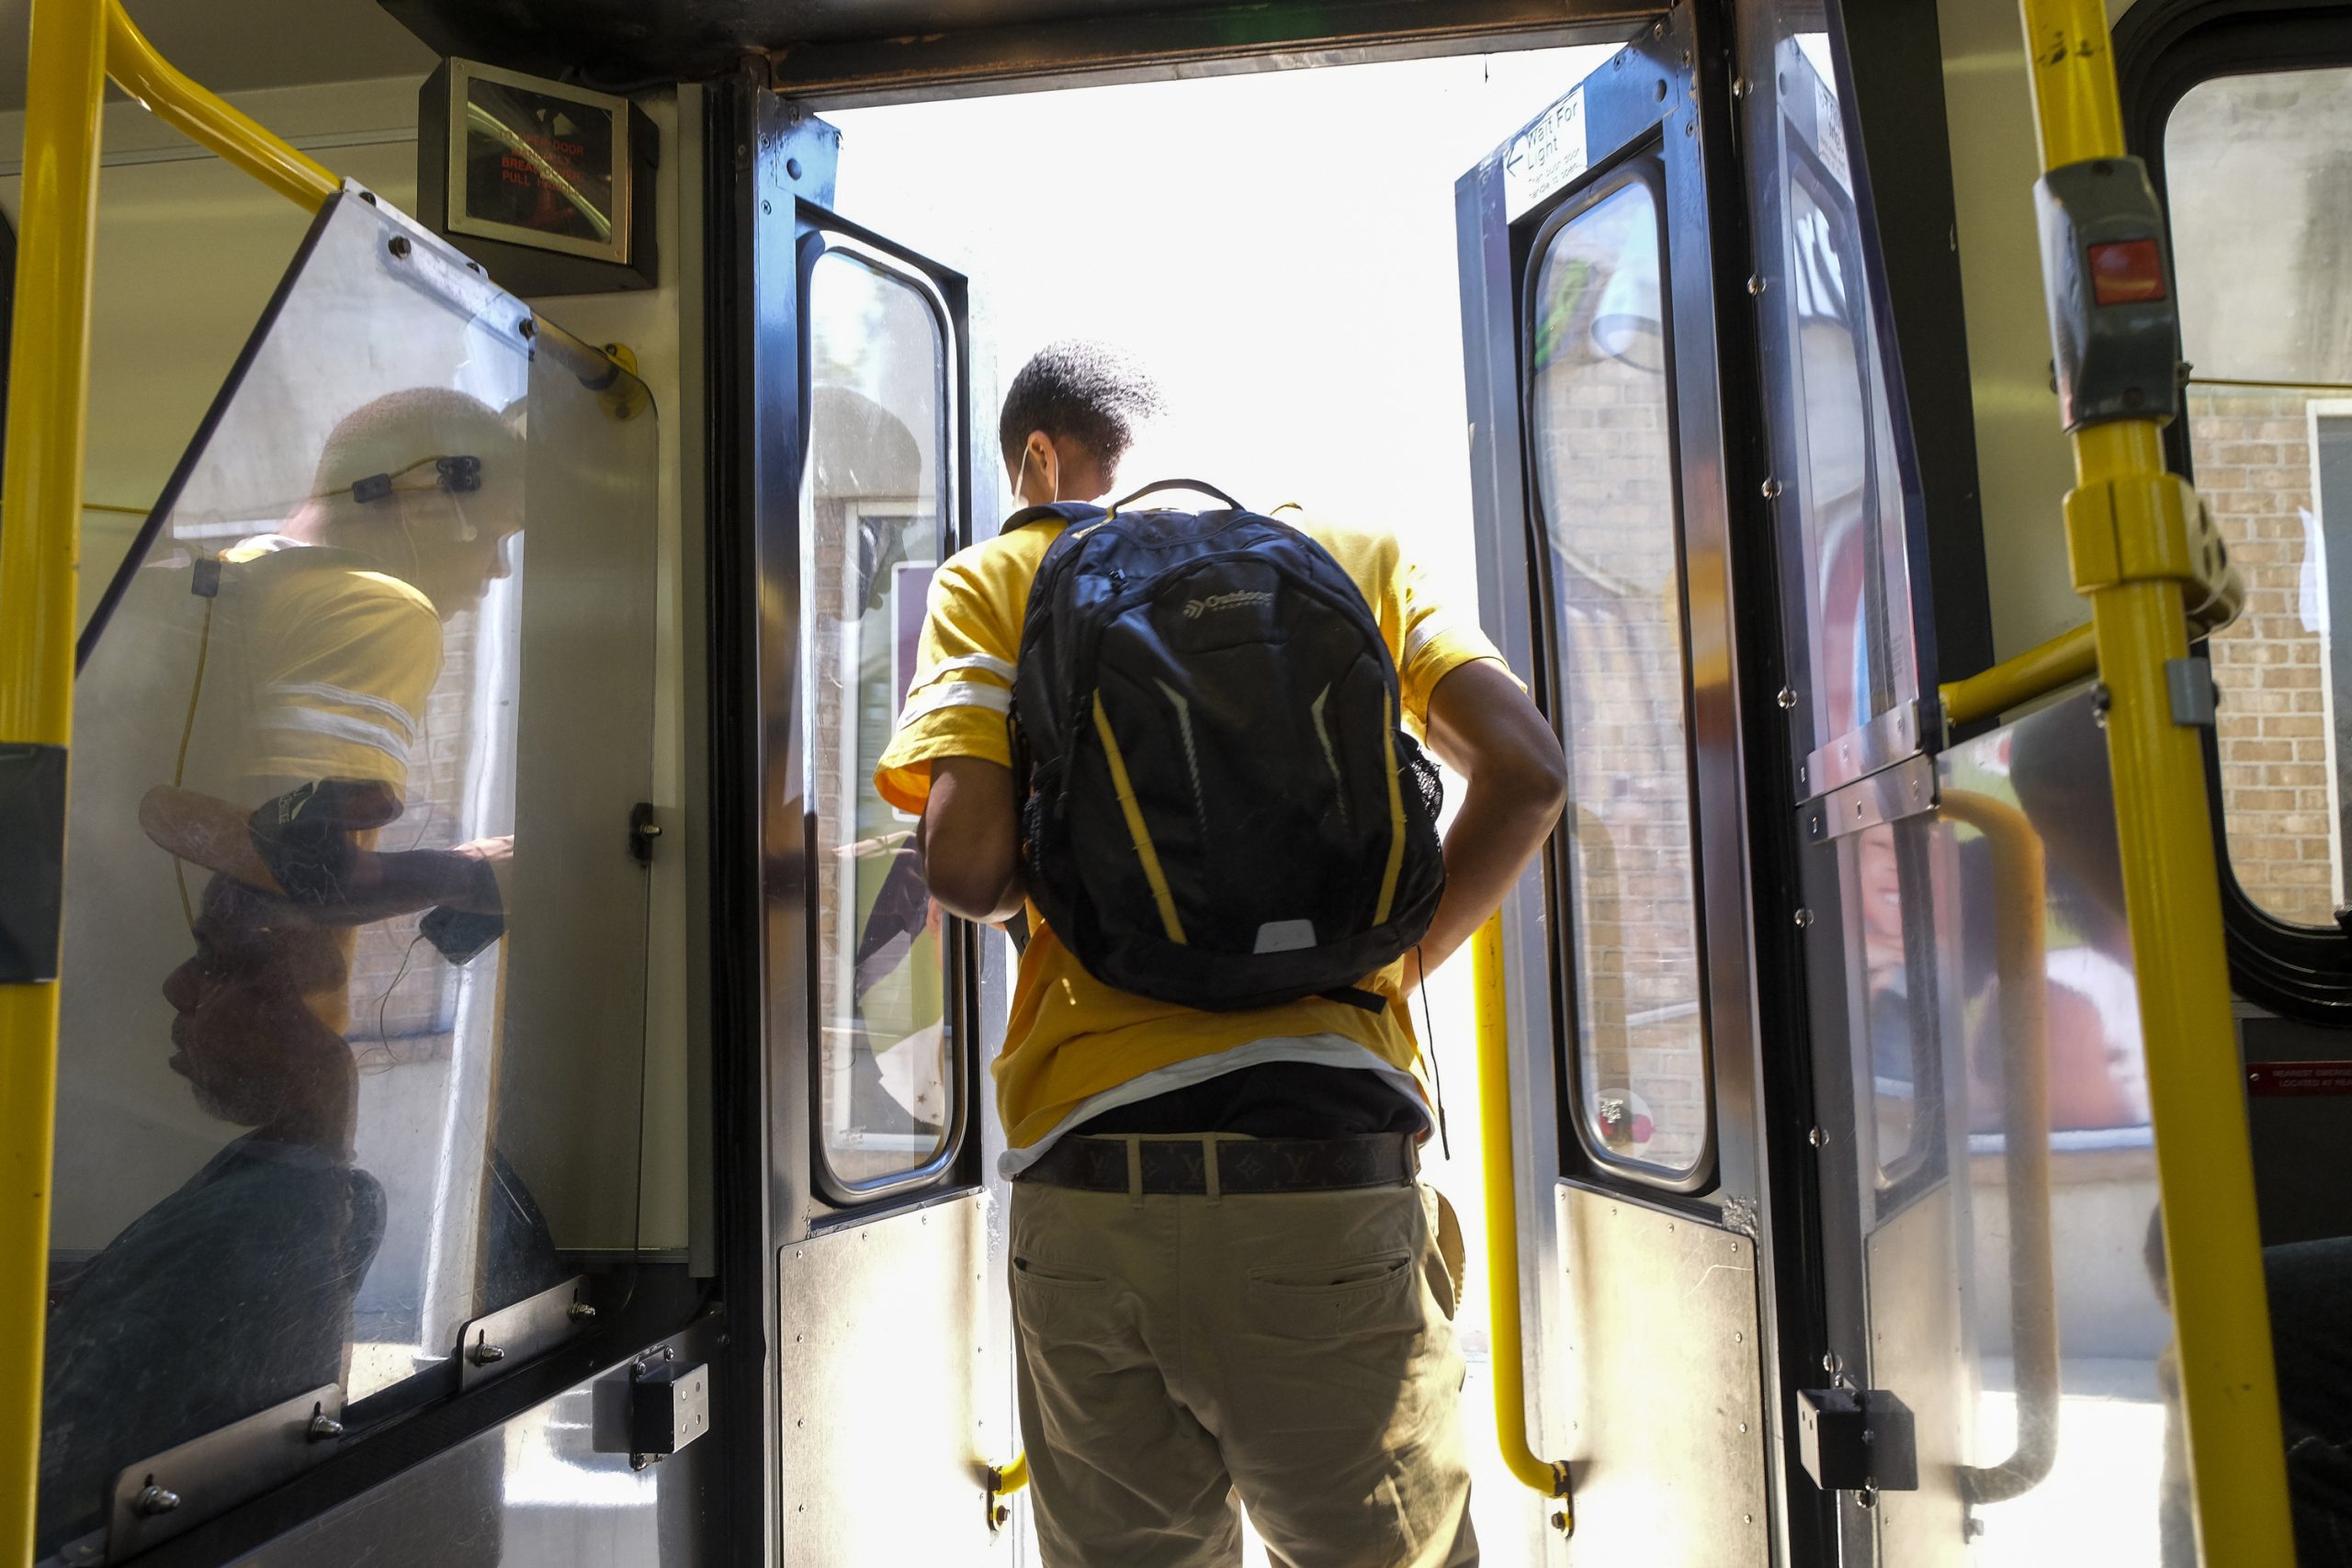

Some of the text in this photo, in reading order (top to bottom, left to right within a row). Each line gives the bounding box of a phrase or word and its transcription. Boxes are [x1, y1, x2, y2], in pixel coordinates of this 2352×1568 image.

[1526, 101, 1578, 149] Wait For
[553, 140, 585, 155] DOOR
[1527, 137, 1559, 170] Light
[502, 170, 530, 187] PULL
